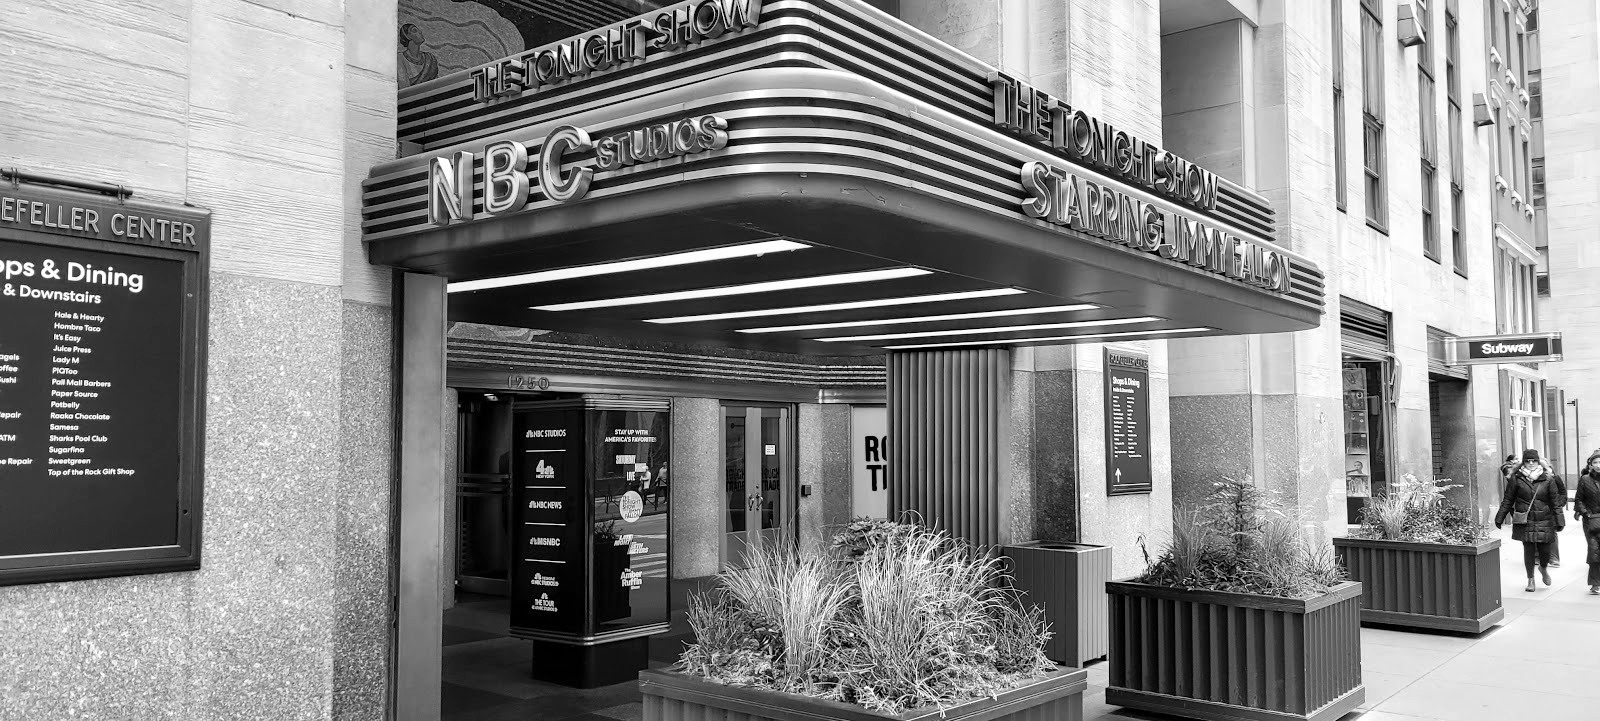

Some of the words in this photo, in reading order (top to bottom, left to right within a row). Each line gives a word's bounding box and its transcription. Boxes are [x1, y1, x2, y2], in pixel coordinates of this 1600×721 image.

[469, 59, 522, 102] THE
[520, 19, 652, 92] TONIGHT
[653, 0, 761, 51] SHOW
[988, 71, 1053, 147] THE
[1047, 99, 1158, 187] TONIGHT
[1154, 151, 1218, 211] SHOW
[428, 125, 593, 225] NBC
[596, 115, 729, 170] STUDIOS
[110, 213, 197, 246] CENTER
[1021, 161, 1162, 251] STARRING
[1159, 213, 1228, 274] JIMMY
[1225, 235, 1291, 294] FALLON
[0, 259, 35, 280] ps
[41, 259, 61, 280] &
[67, 261, 144, 293] Dining
[3, 283, 16, 297] &
[20, 284, 102, 304] Downstairs
[55, 311, 72, 319] Hale
[80, 313, 104, 323] Hearty
[54, 322, 83, 330] Hombre
[65, 335, 81, 343] Easy
[1481, 343, 1534, 354] Subway
[53, 356, 71, 365] Lady
[508, 375, 550, 391] 1250
[51, 390, 73, 398] Paper
[51, 401, 80, 409] Potbelly
[0, 411, 22, 419] epair
[533, 430, 544, 438] NBC
[544, 429, 566, 438] STUDIOS
[49, 446, 84, 454] Sugarfina
[8, 457, 33, 466] Repair
[48, 469, 61, 477] Top
[117, 468, 135, 476] Shop
[537, 537, 560, 546] MSNBC
[621, 570, 642, 579] Amber
[622, 577, 642, 587] Ruffin
